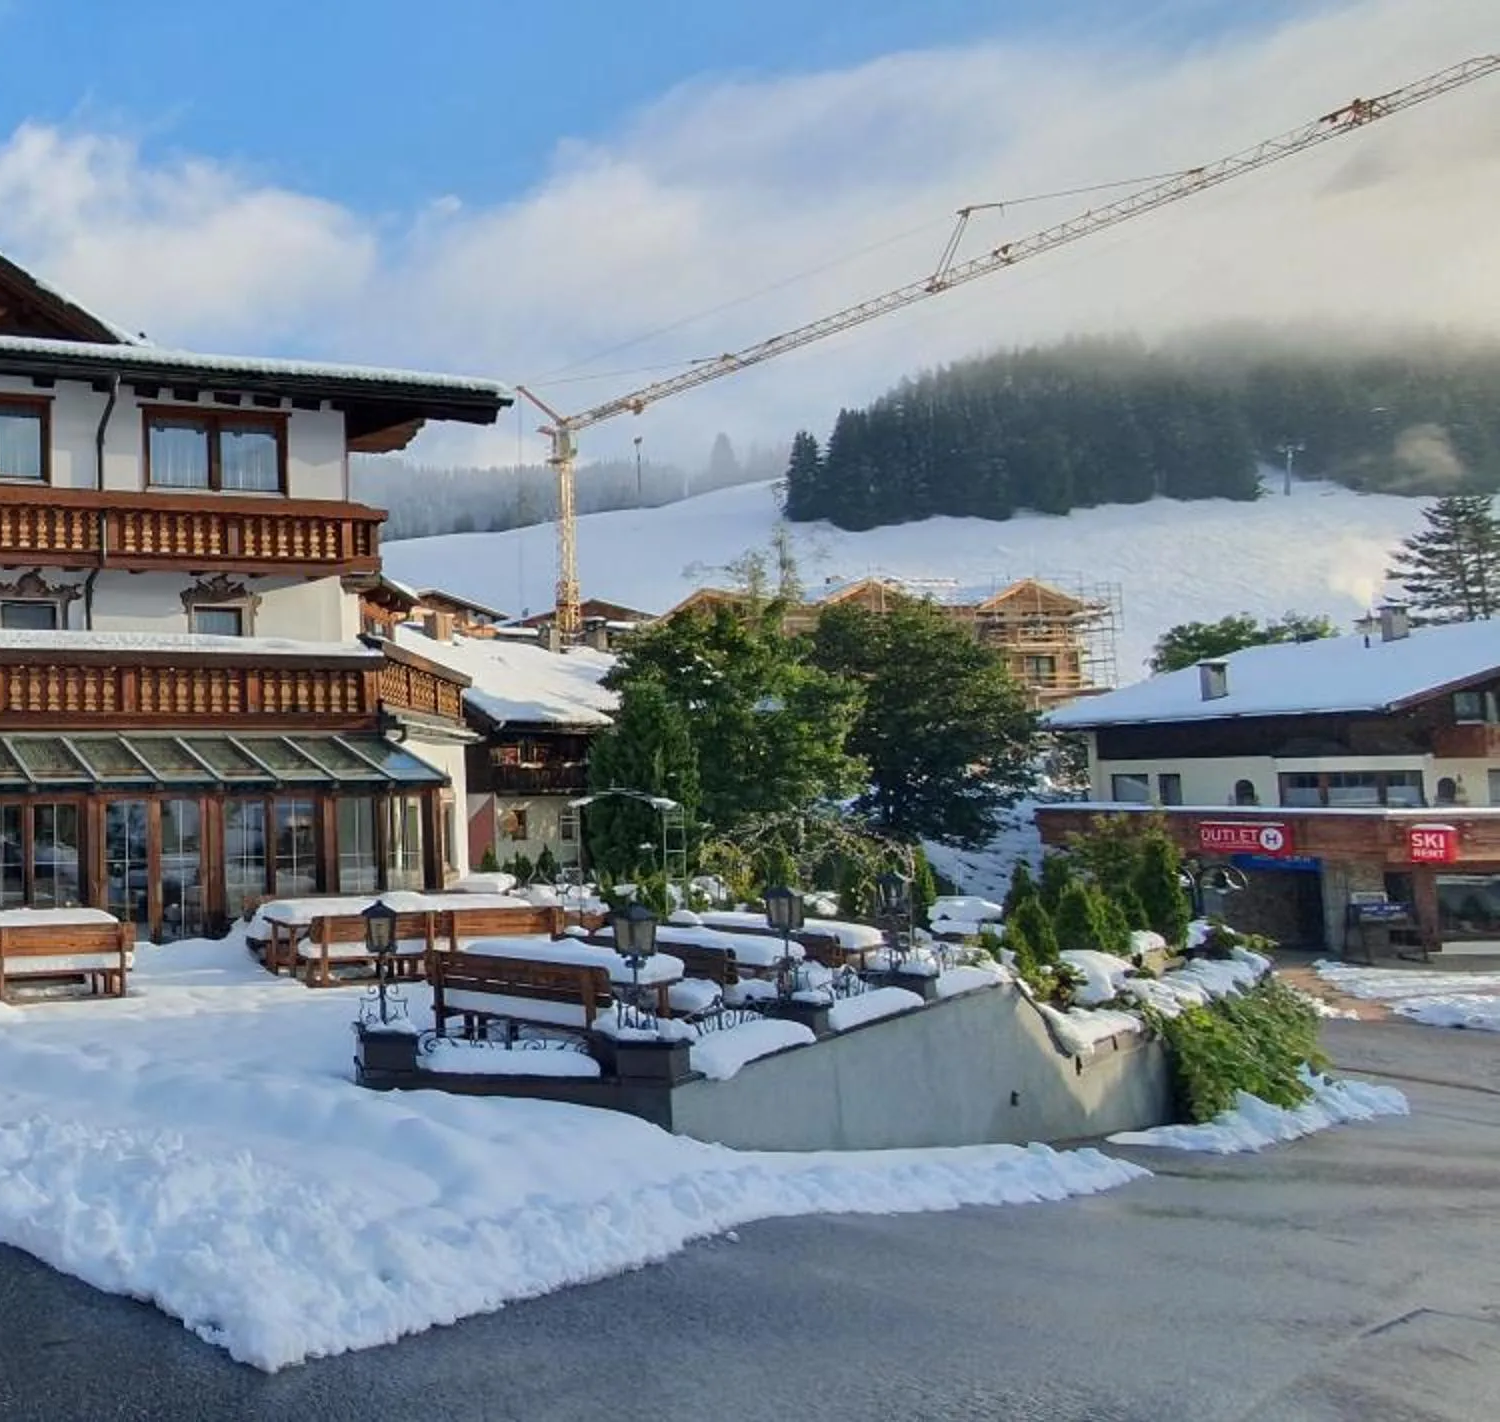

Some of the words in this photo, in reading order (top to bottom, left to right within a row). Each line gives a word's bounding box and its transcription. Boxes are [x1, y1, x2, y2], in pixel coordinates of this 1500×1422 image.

[1201, 828, 1259, 841] OUTLET
[1411, 833, 1445, 849] SKI
[1413, 848, 1445, 858] RENT
